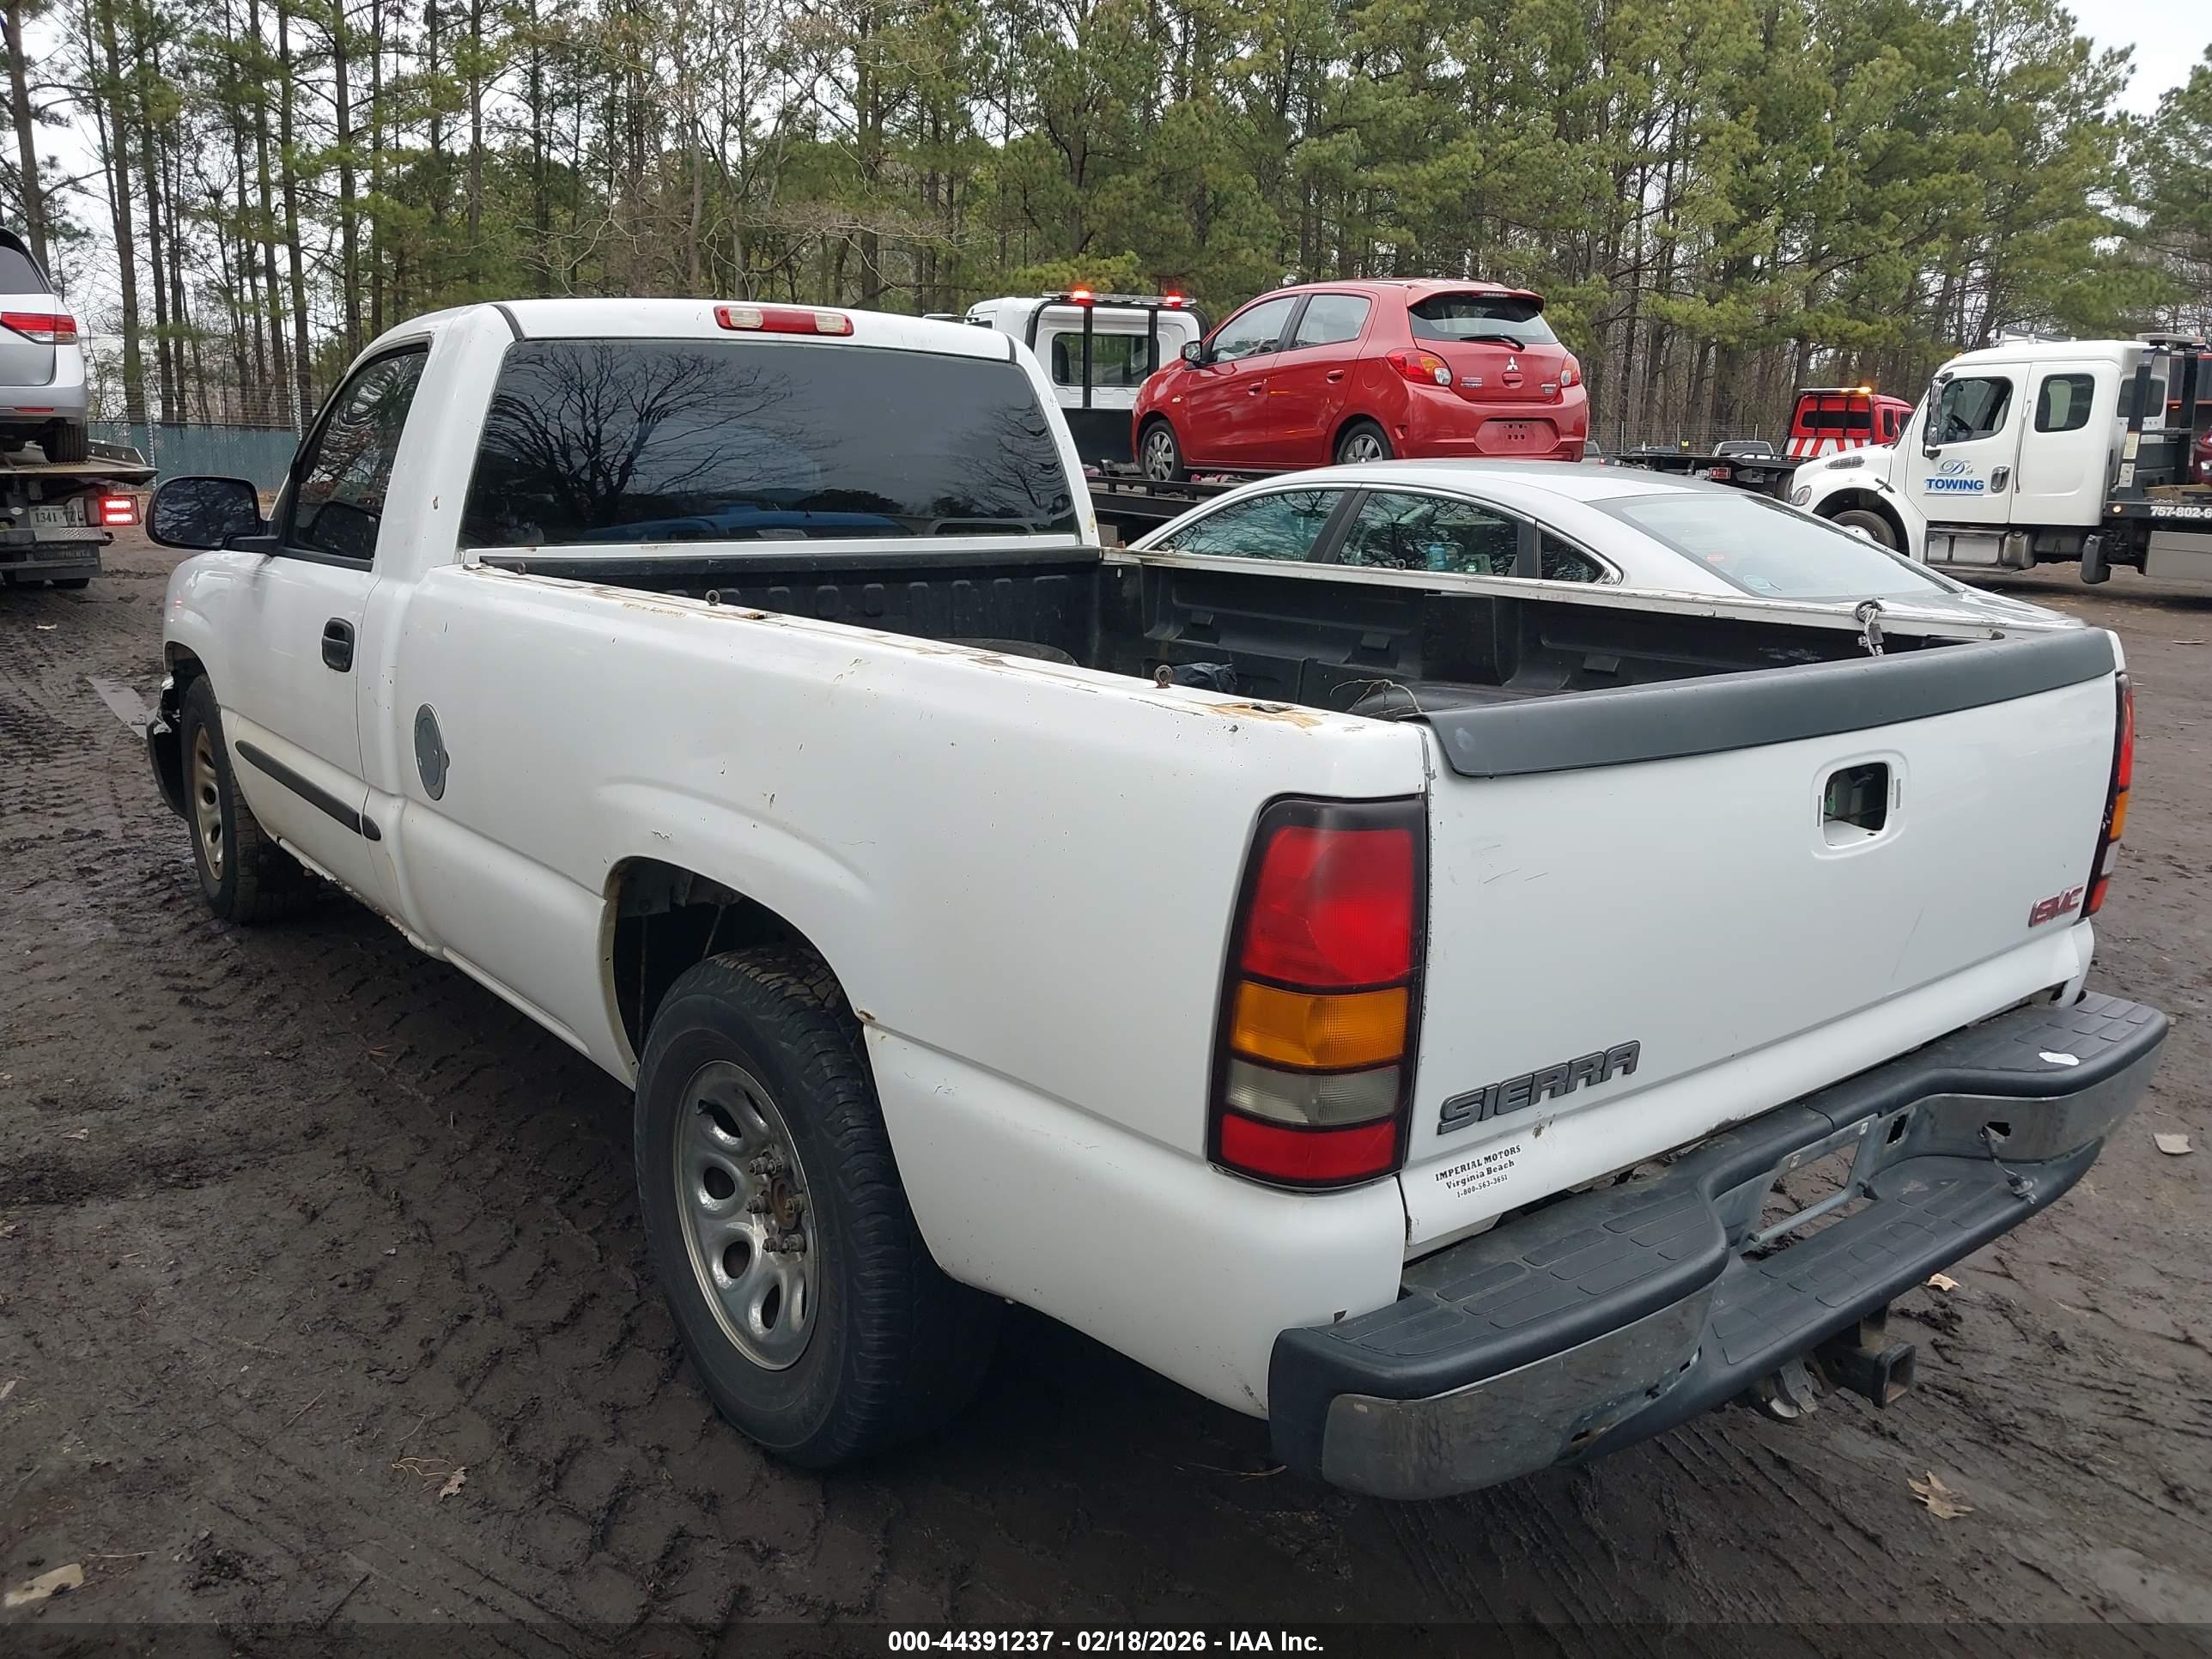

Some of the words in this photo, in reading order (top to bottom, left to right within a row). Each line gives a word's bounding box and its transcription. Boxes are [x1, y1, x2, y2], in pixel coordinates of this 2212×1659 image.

[1926, 478, 1984, 491] TOWING
[2028, 884, 2083, 927] GMC
[1437, 1040, 1641, 1135] SIERRA
[1435, 1158, 1483, 1182] IMPERIAL
[1483, 1145, 1522, 1165] MOTORS
[1445, 1170, 1485, 1189] Virginia
[1486, 1159, 1516, 1176] Beach
